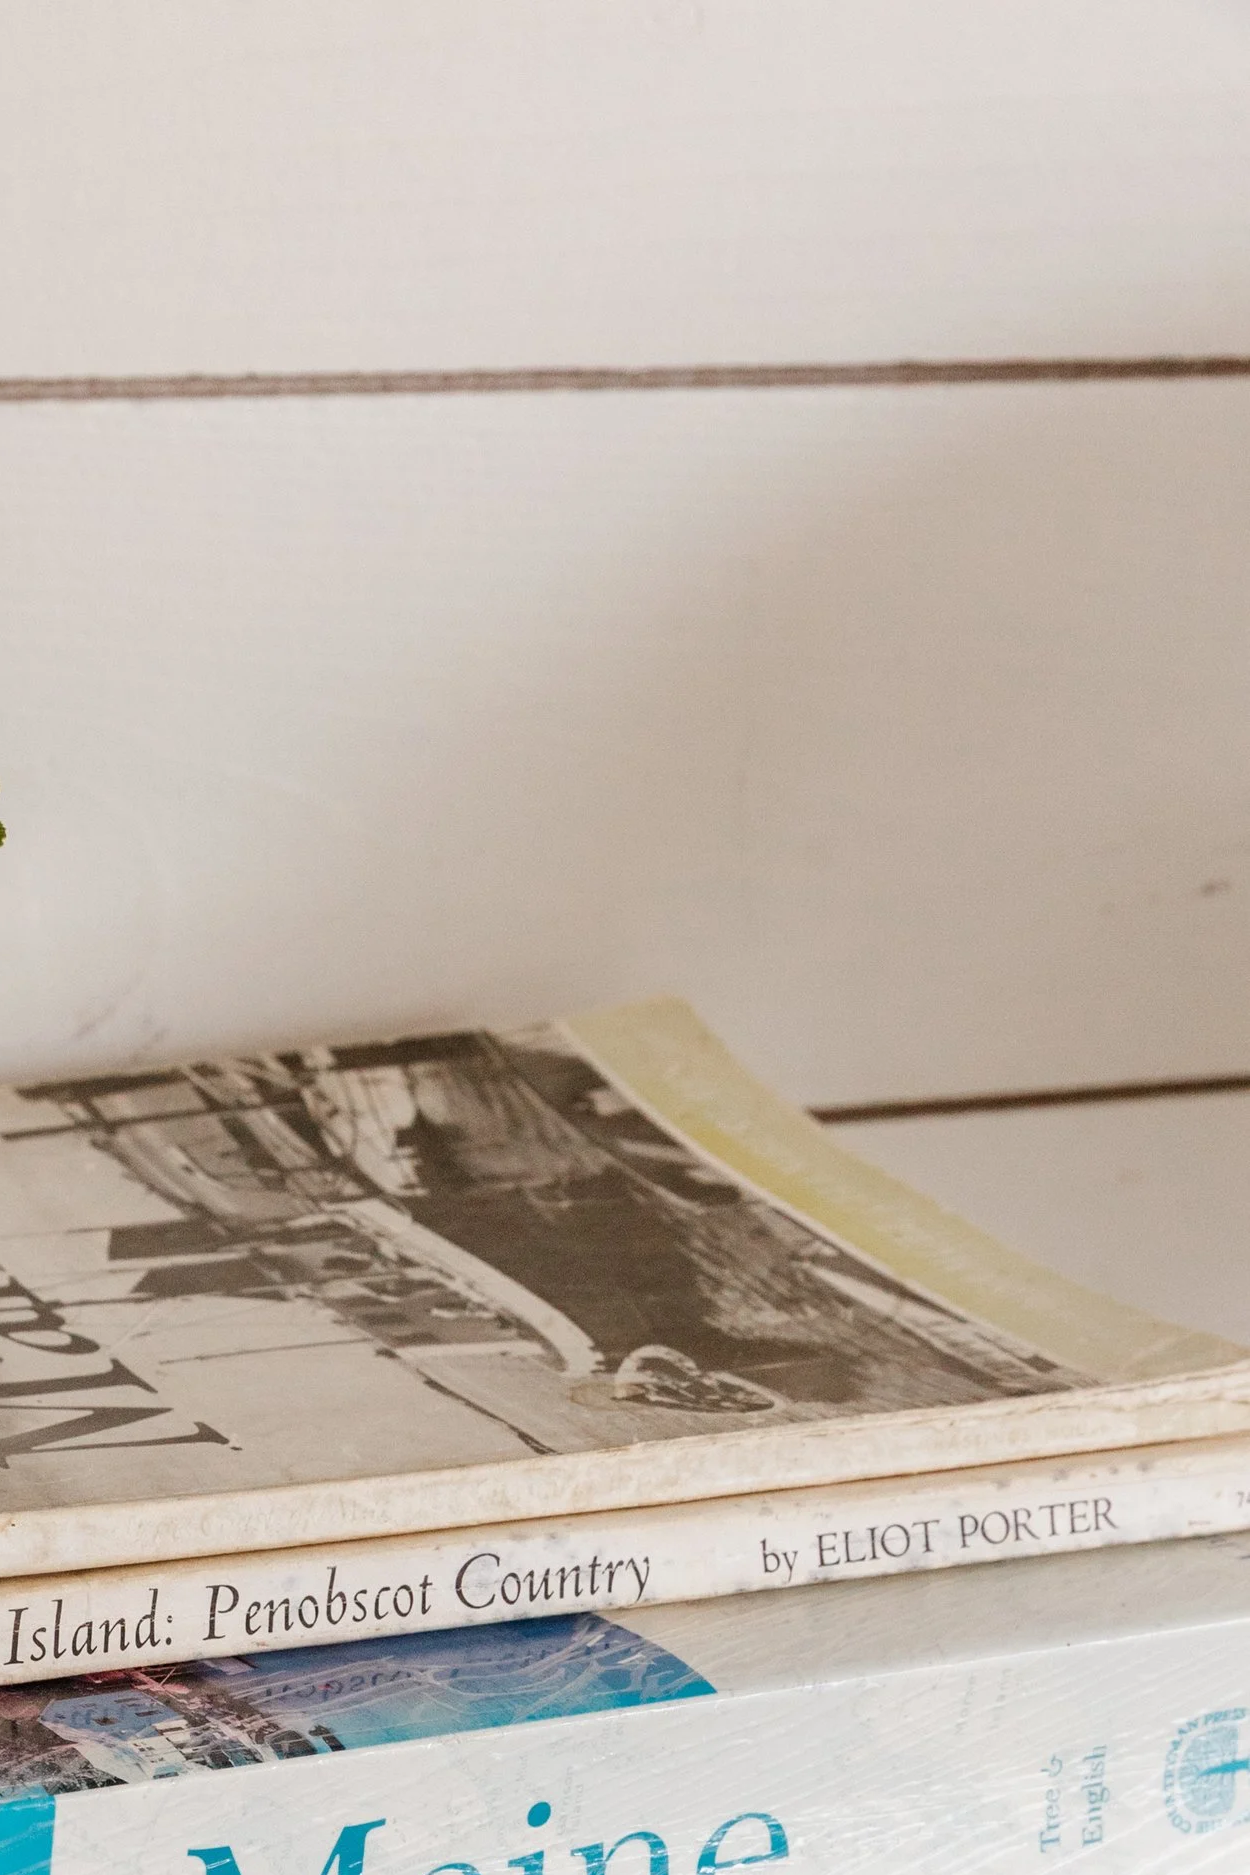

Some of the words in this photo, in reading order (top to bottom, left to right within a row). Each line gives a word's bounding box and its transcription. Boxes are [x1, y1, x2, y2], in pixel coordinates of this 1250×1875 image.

[2, 1586, 174, 1667] Island:
[202, 1565, 433, 1642] Penobscot
[454, 1552, 651, 1610] Country
[759, 1537, 799, 1582] by
[815, 1518, 941, 1568] ELIOT
[956, 1496, 1120, 1549] PORTER
[1039, 1787, 1061, 1853] Tree
[1081, 1744, 1111, 1848] English
